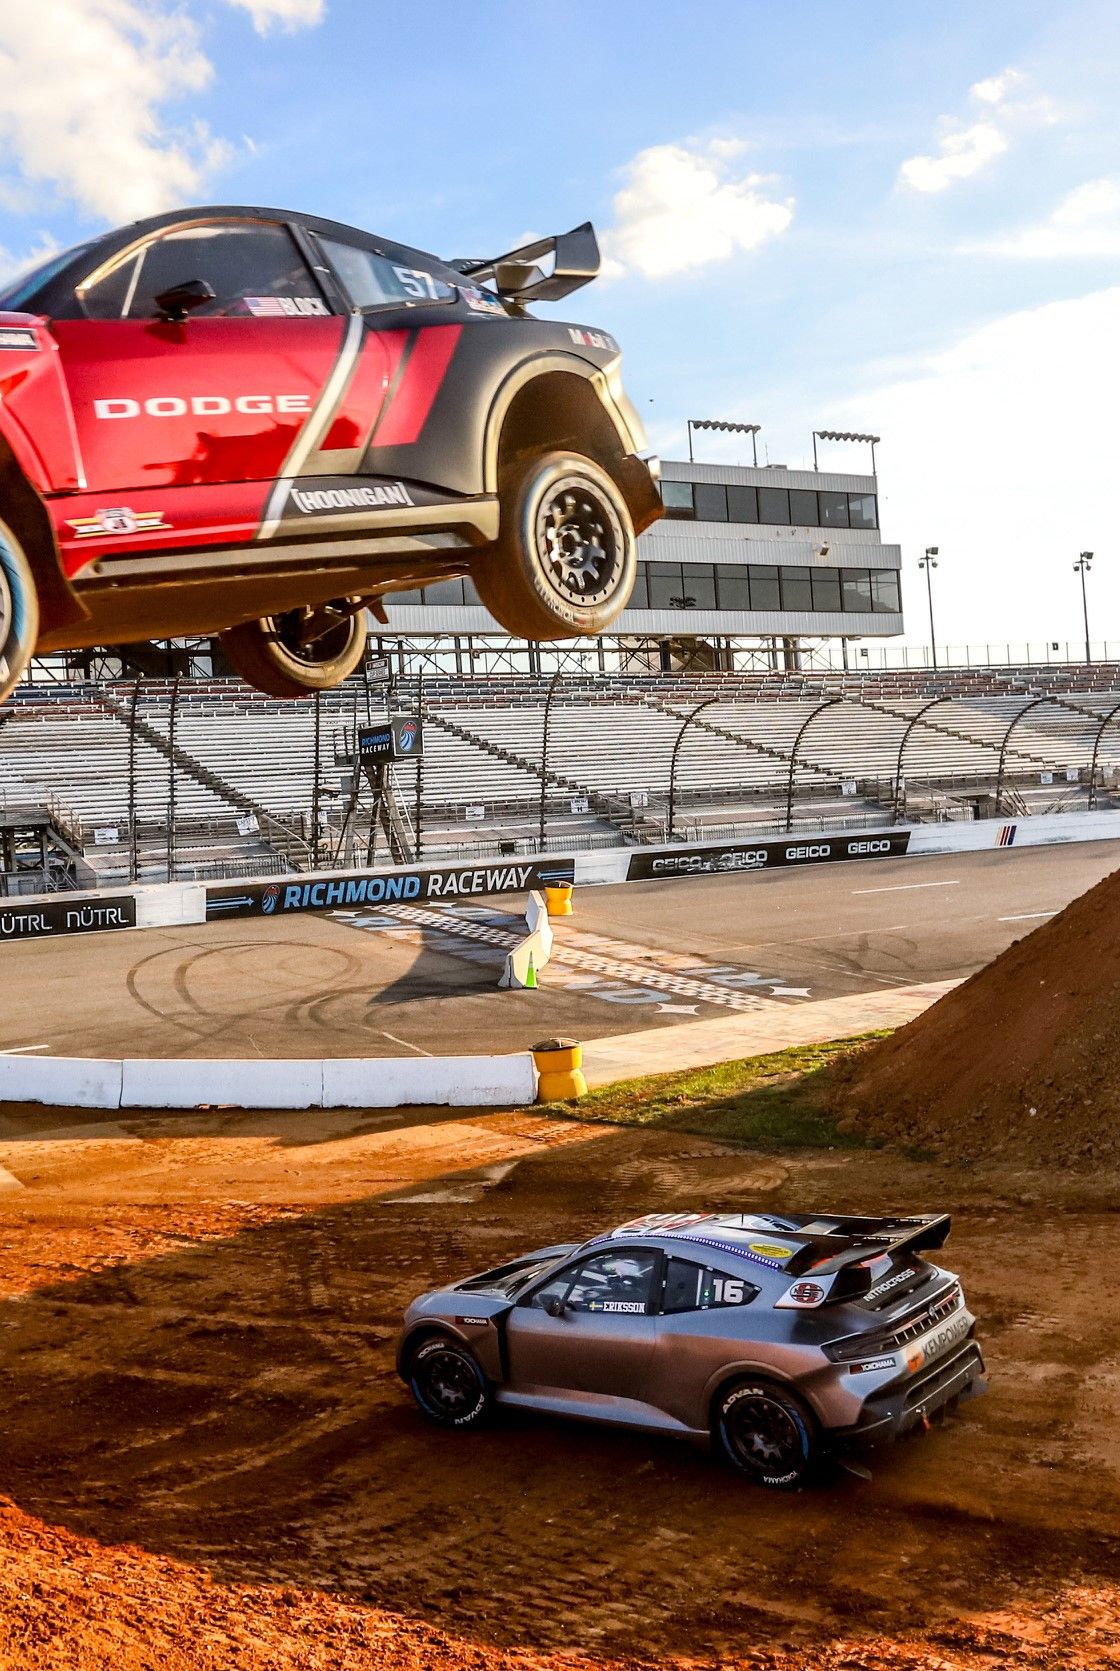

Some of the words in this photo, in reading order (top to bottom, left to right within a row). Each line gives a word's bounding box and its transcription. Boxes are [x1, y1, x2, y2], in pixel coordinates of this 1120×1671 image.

[391, 266, 439, 300] 57
[94, 395, 312, 419] DODGE
[361, 743, 390, 754] RACEWAY
[362, 733, 391, 746] RICHMOND
[786, 845, 830, 859] GEICO
[848, 840, 891, 853] GEICO
[284, 876, 421, 908] RICHMOND
[427, 866, 534, 896] RACEWAY
[713, 1279, 745, 1303] 16
[863, 1268, 916, 1302] NITROCROSS
[603, 1302, 646, 1314] ERIKSSON
[922, 1316, 968, 1357] KEMPOWER
[861, 1358, 895, 1371] YOKOHAMA
[455, 1394, 485, 1424] ADVAN
[722, 1388, 764, 1414] ADVAN
[763, 1470, 798, 1484] YOKOHAMA
